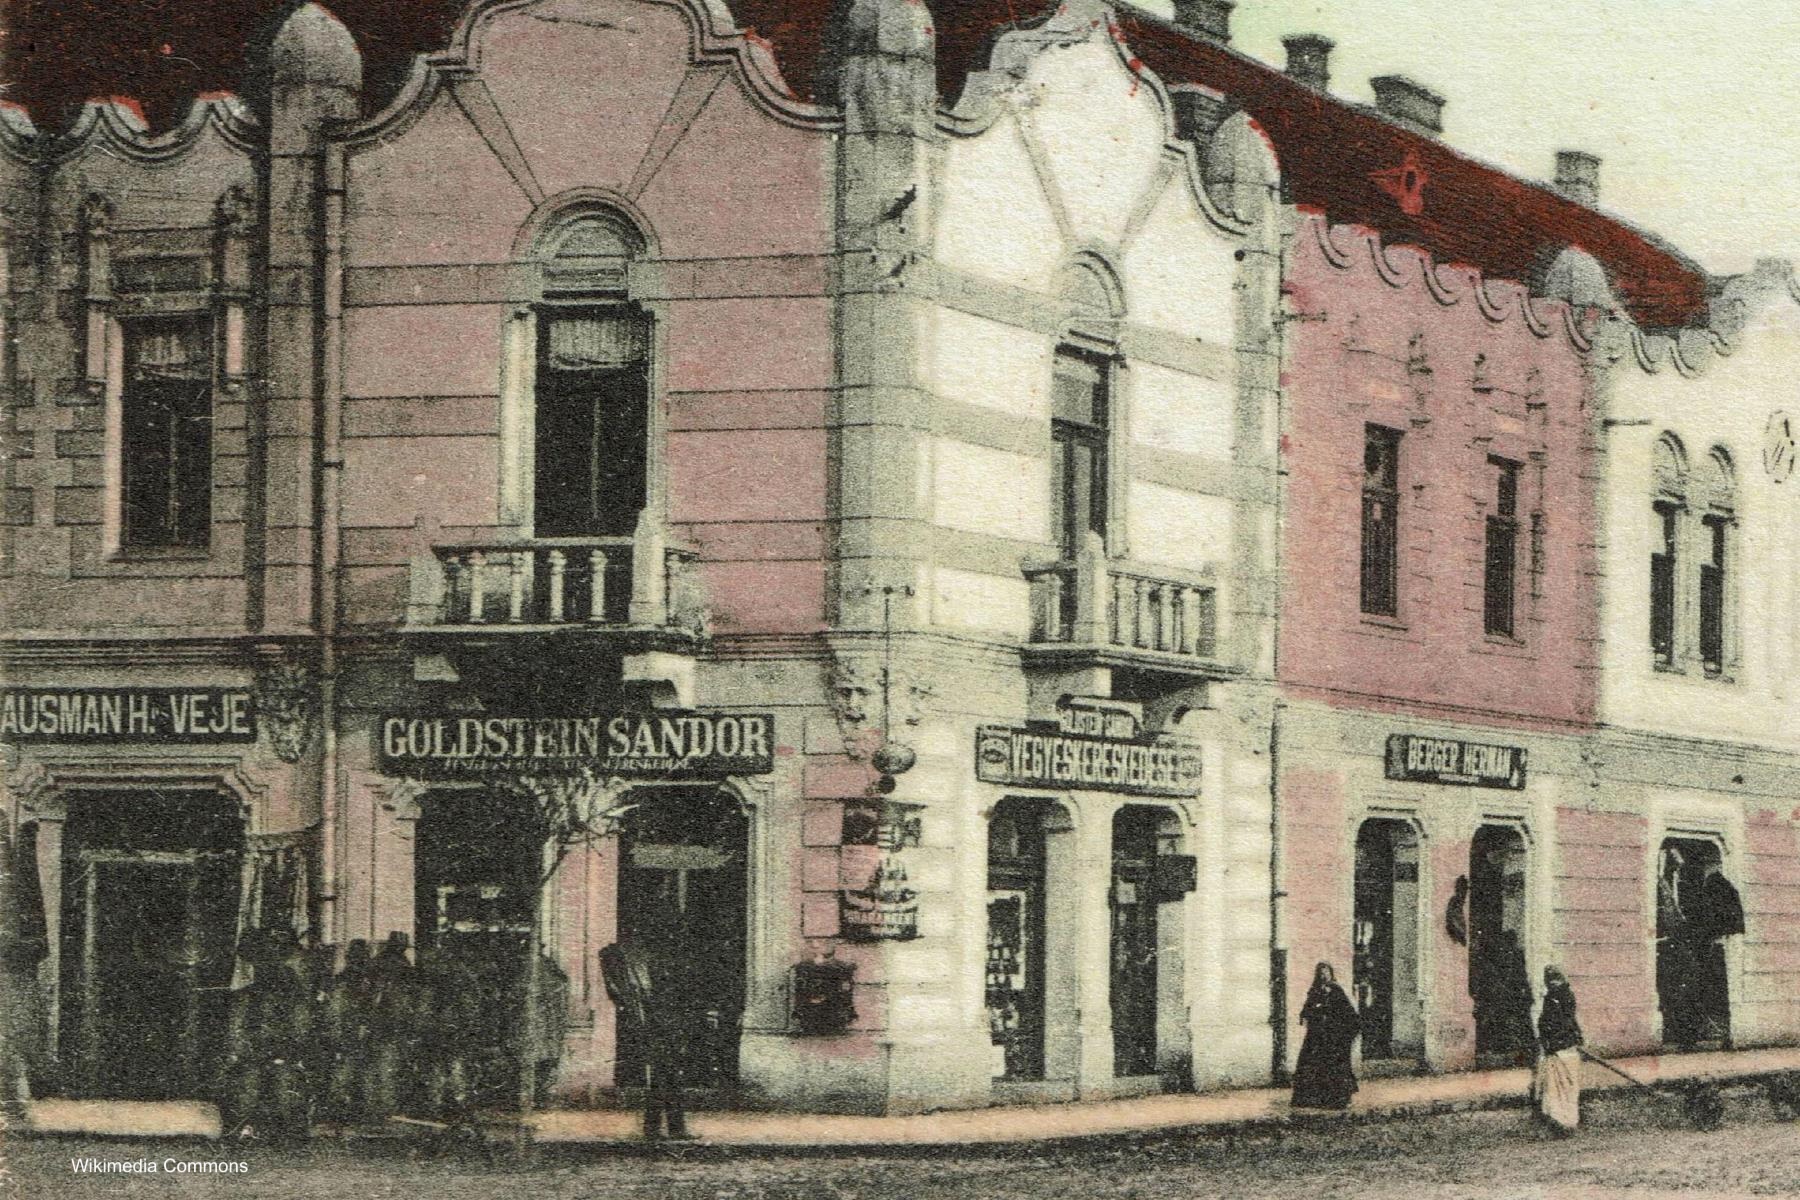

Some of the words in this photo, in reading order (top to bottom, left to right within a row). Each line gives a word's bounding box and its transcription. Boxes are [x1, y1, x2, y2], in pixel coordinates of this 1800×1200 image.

[170, 694, 250, 734] VEJE
[385, 717, 600, 758] GOLDSTEIN
[1408, 737, 1459, 773] BERGER
